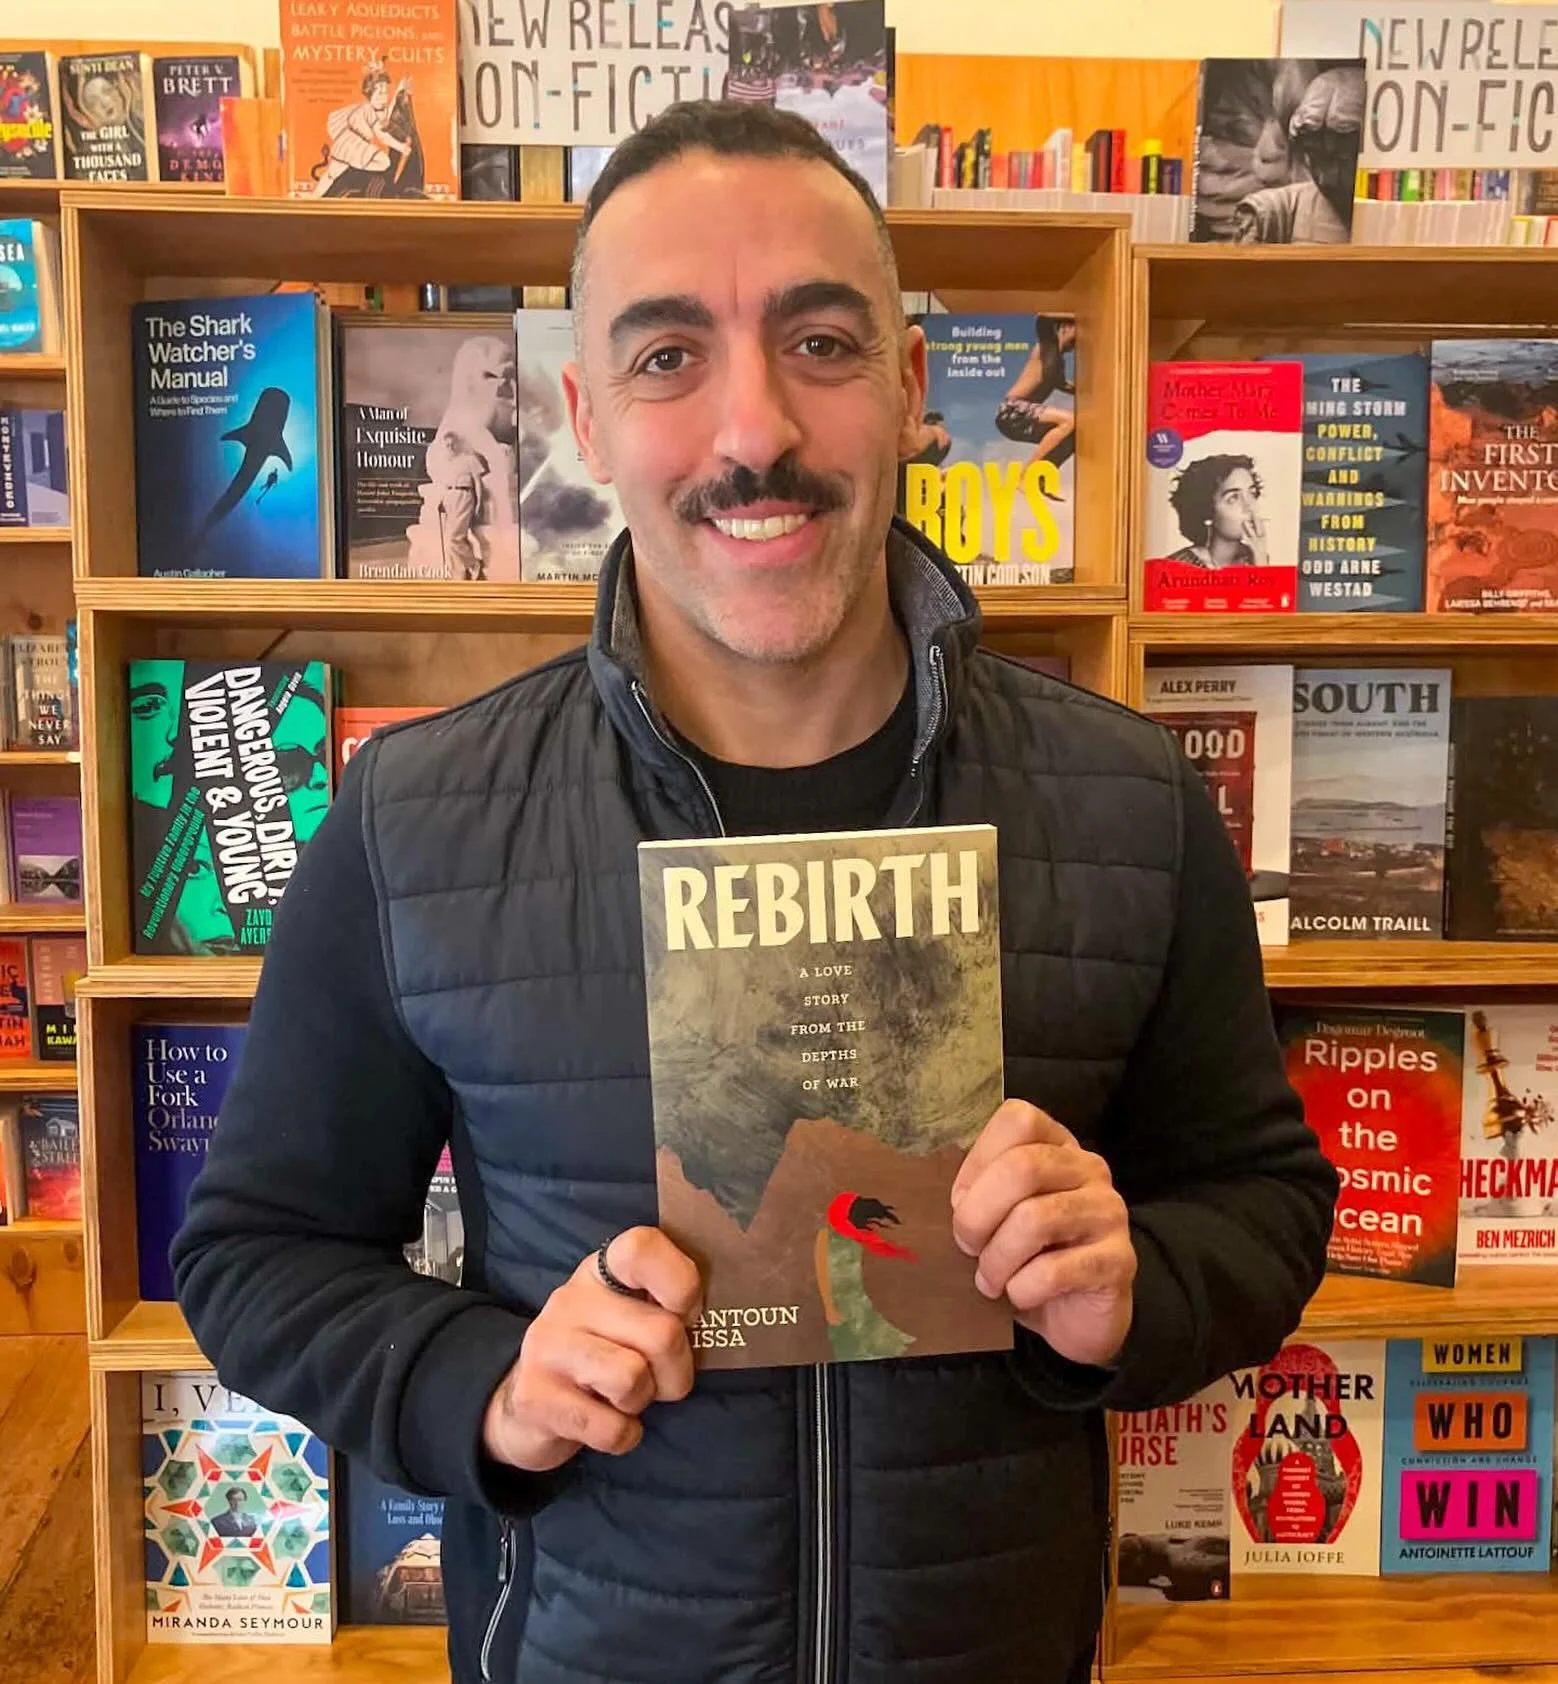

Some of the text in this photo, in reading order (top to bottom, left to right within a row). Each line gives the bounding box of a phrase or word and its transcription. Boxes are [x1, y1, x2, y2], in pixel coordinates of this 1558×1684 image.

[290, 3, 337, 17] LEAKY
[291, 24, 344, 38] BATTLE
[1359, 18, 1448, 70] NEW
[292, 45, 446, 64] MYSTERY CULTS
[169, 64, 210, 75] PETER
[163, 77, 232, 97] BRETT
[1359, 79, 1555, 153] ON-FIC
[100, 125, 130, 139] GIRL
[90, 144, 114, 152] WITH
[73, 153, 142, 169] THOUSAND
[146, 312, 253, 338] The Shark
[952, 326, 1003, 339] Building
[148, 340, 257, 363] Watcher's
[966, 342, 1002, 353] young
[1004, 342, 1029, 350] men
[952, 353, 1001, 364] from the
[151, 366, 229, 390] Manual
[947, 367, 1006, 377] inside out
[1331, 378, 1361, 393] THE
[368, 407, 394, 420] Man
[395, 406, 408, 420] of
[1304, 401, 1407, 416] MING STORM
[357, 428, 426, 448] Exquisite
[1317, 423, 1378, 440] POWER,
[1504, 425, 1540, 440] THE
[357, 451, 415, 468] Honour
[1305, 447, 1384, 461] CONFLICT
[1485, 443, 1558, 465] FIRST
[1328, 469, 1360, 484] AND
[1440, 469, 1558, 492] INVENTO
[1302, 492, 1385, 507] WARNINGS
[906, 460, 1061, 564] BOYS
[1321, 514, 1364, 529] FROM
[1308, 537, 1377, 552] HISTORY
[359, 563, 452, 579] Brendan Cook
[987, 564, 1051, 585] COULSON
[1340, 560, 1381, 575] ARNE
[1309, 582, 1373, 597] WESTAD
[1160, 680, 1237, 694] ALEX PERRY
[1293, 683, 1440, 714] SOUTH
[40, 704, 58, 715] WE
[28, 719, 71, 731] NEVER
[184, 672, 234, 779] VIOLENT
[38, 734, 62, 745] SAY
[224, 666, 288, 821] DANGEROUS,
[1173, 729, 1245, 759] OOD
[206, 786, 268, 904] & YOUNG
[663, 850, 979, 951] REBIRTH
[246, 909, 273, 926] ZAYD
[1290, 916, 1432, 931] ALCOLM TRAILL
[800, 965, 852, 978] A LOVE
[804, 993, 849, 1006] STORY
[791, 1020, 866, 1035] FROM THE
[145, 1039, 228, 1062] How to
[801, 1049, 857, 1063] DEPTHS
[1304, 1039, 1438, 1074] Ripples
[146, 1062, 207, 1084] Use a
[802, 1077, 859, 1090] OF WAR
[148, 1084, 199, 1106] Fork
[1347, 1087, 1391, 1111] on
[1338, 1121, 1398, 1151] the
[1336, 1166, 1432, 1196] osmic
[1459, 1158, 1558, 1199] HECKMA
[1335, 1208, 1422, 1236] cean
[1476, 1230, 1555, 1248] BEN MEZRICH
[693, 1306, 799, 1328] ANTOUN
[692, 1329, 747, 1348] ISSA
[1434, 1343, 1511, 1365] WOMEN
[154, 1384, 264, 1416] I, VE
[1250, 1413, 1348, 1439] LAND
[1428, 1402, 1513, 1439] WHO
[381, 1500, 439, 1512] A Family Story
[1416, 1480, 1521, 1528] WIN
[408, 1514, 424, 1525] and
[1165, 1520, 1223, 1529] LUKE KEMP
[1244, 1551, 1344, 1566] JULIA IOFFE
[1399, 1546, 1534, 1559] ANTOINETTE LATTOUF
[152, 1616, 323, 1629] MIRANDA SEYMOUR
